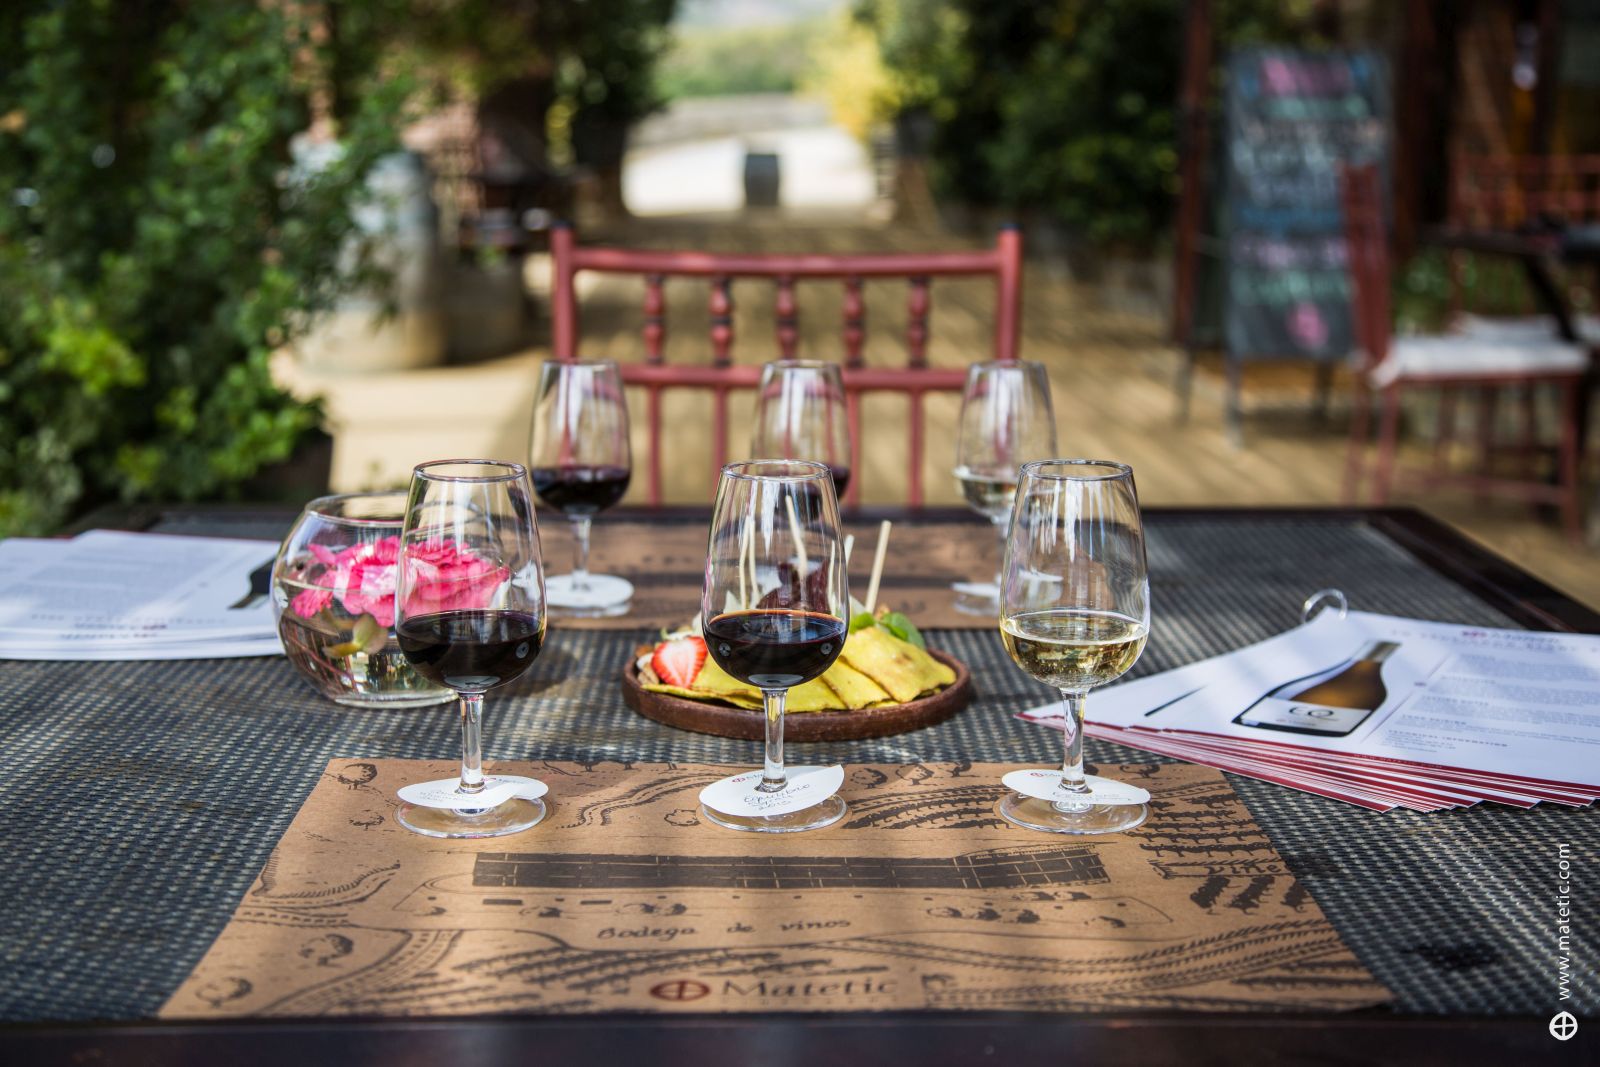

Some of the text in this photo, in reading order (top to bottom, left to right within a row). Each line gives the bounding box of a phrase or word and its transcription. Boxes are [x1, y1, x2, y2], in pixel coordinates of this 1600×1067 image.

[597, 919, 851, 942] Bodega de vinos
[722, 977, 899, 998] Matetic
